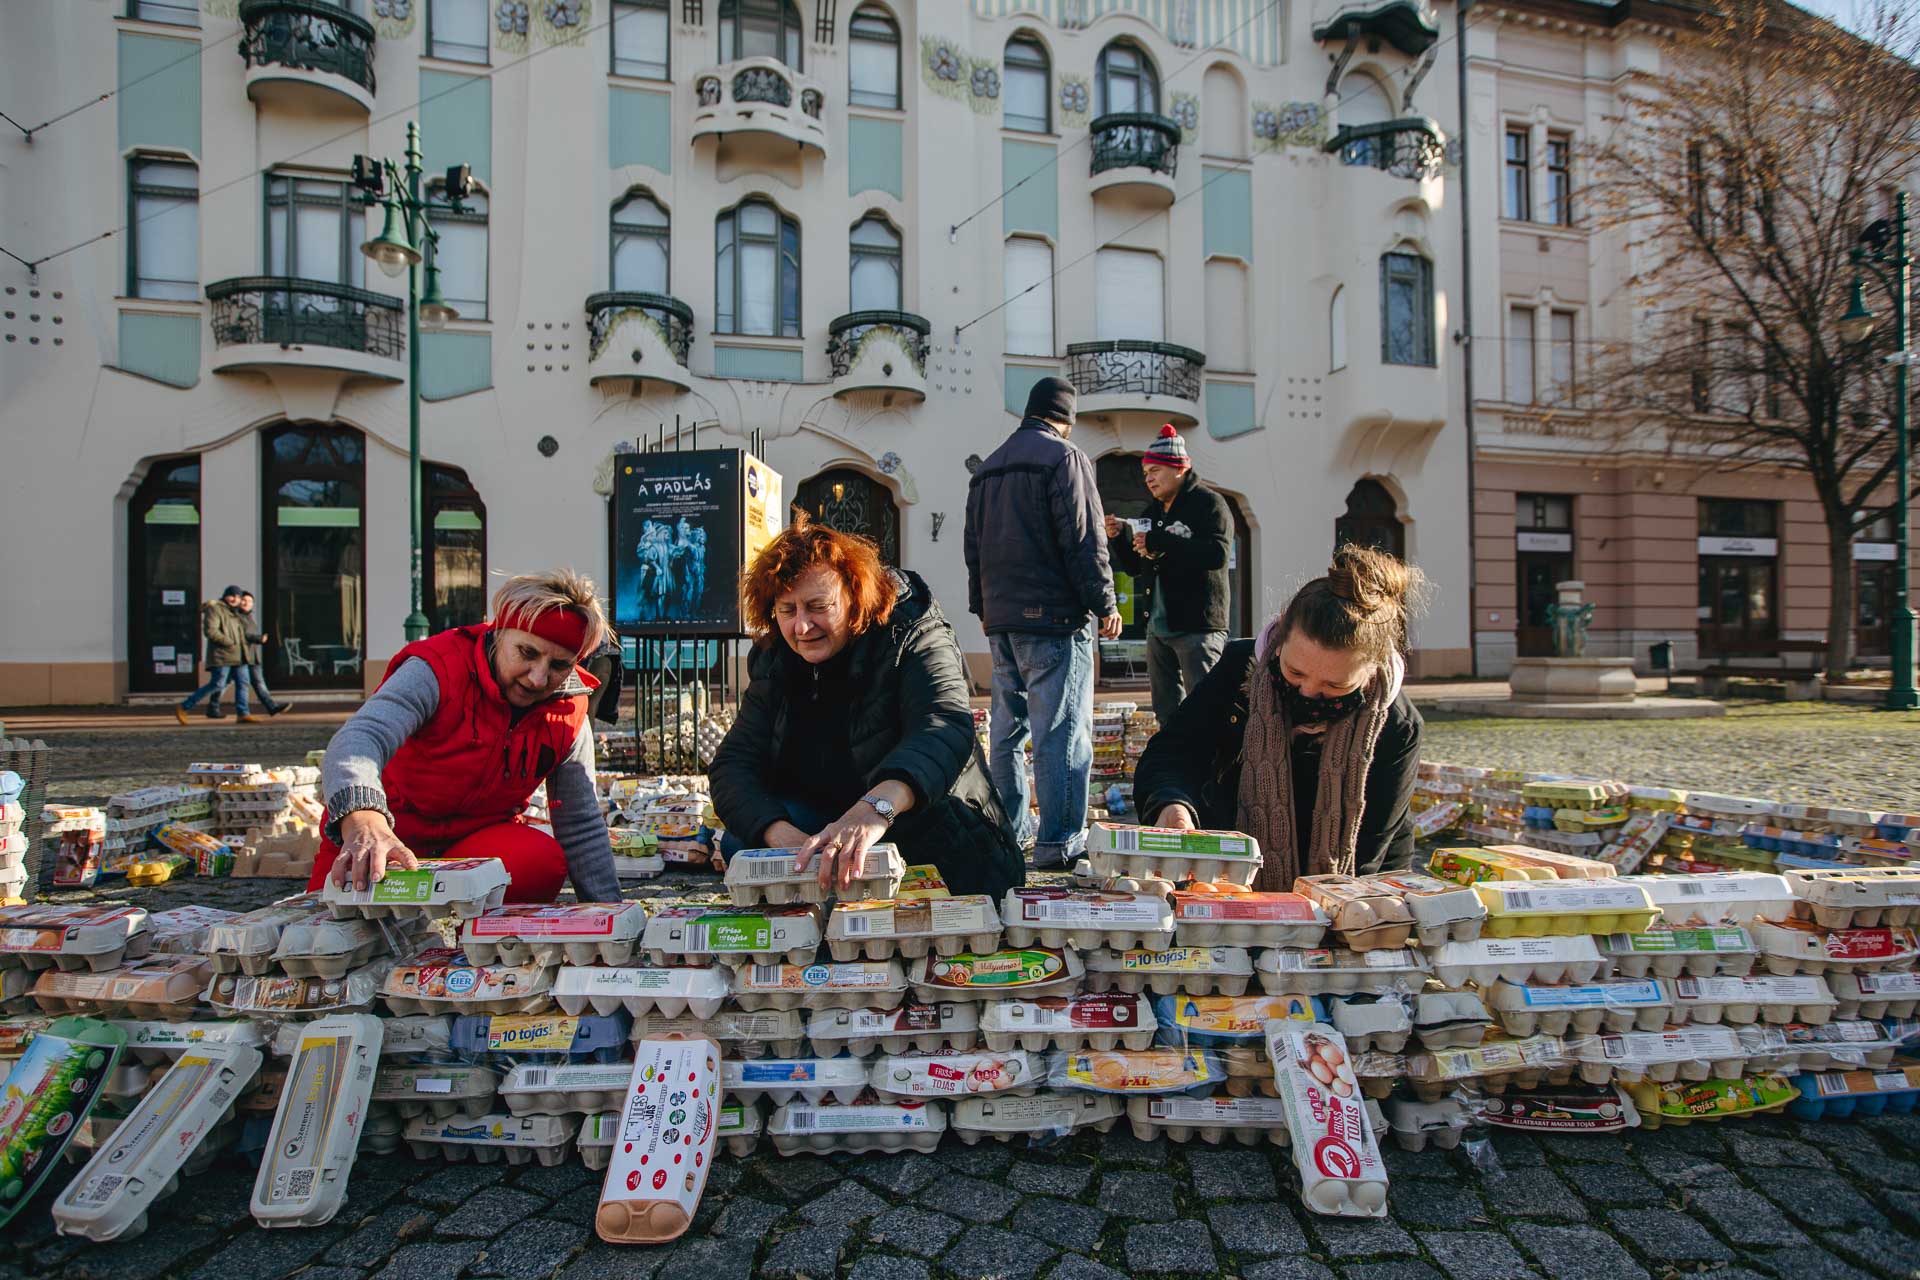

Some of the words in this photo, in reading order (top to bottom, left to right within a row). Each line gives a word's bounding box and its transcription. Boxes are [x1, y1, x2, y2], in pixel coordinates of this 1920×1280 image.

[638, 484, 648, 496] A
[654, 472, 712, 494] PADLÁS
[1138, 954, 1152, 966] 10
[1154, 949, 1187, 966] tojás!
[502, 1030, 516, 1042] 10
[935, 1067, 953, 1078] FRISS
[1120, 1076, 1150, 1086] L-XL
[296, 1102, 312, 1142] Szerencsi
[306, 1064, 326, 1102] tojás
[1690, 1101, 1715, 1114] Tojás
[1334, 1110, 1342, 1134] FRISS
[1344, 1105, 1360, 1141] TOJÁS
[1512, 1118, 1550, 1126] ÁLLATBARÁT
[1577, 1119, 1596, 1128] TOJÁS
